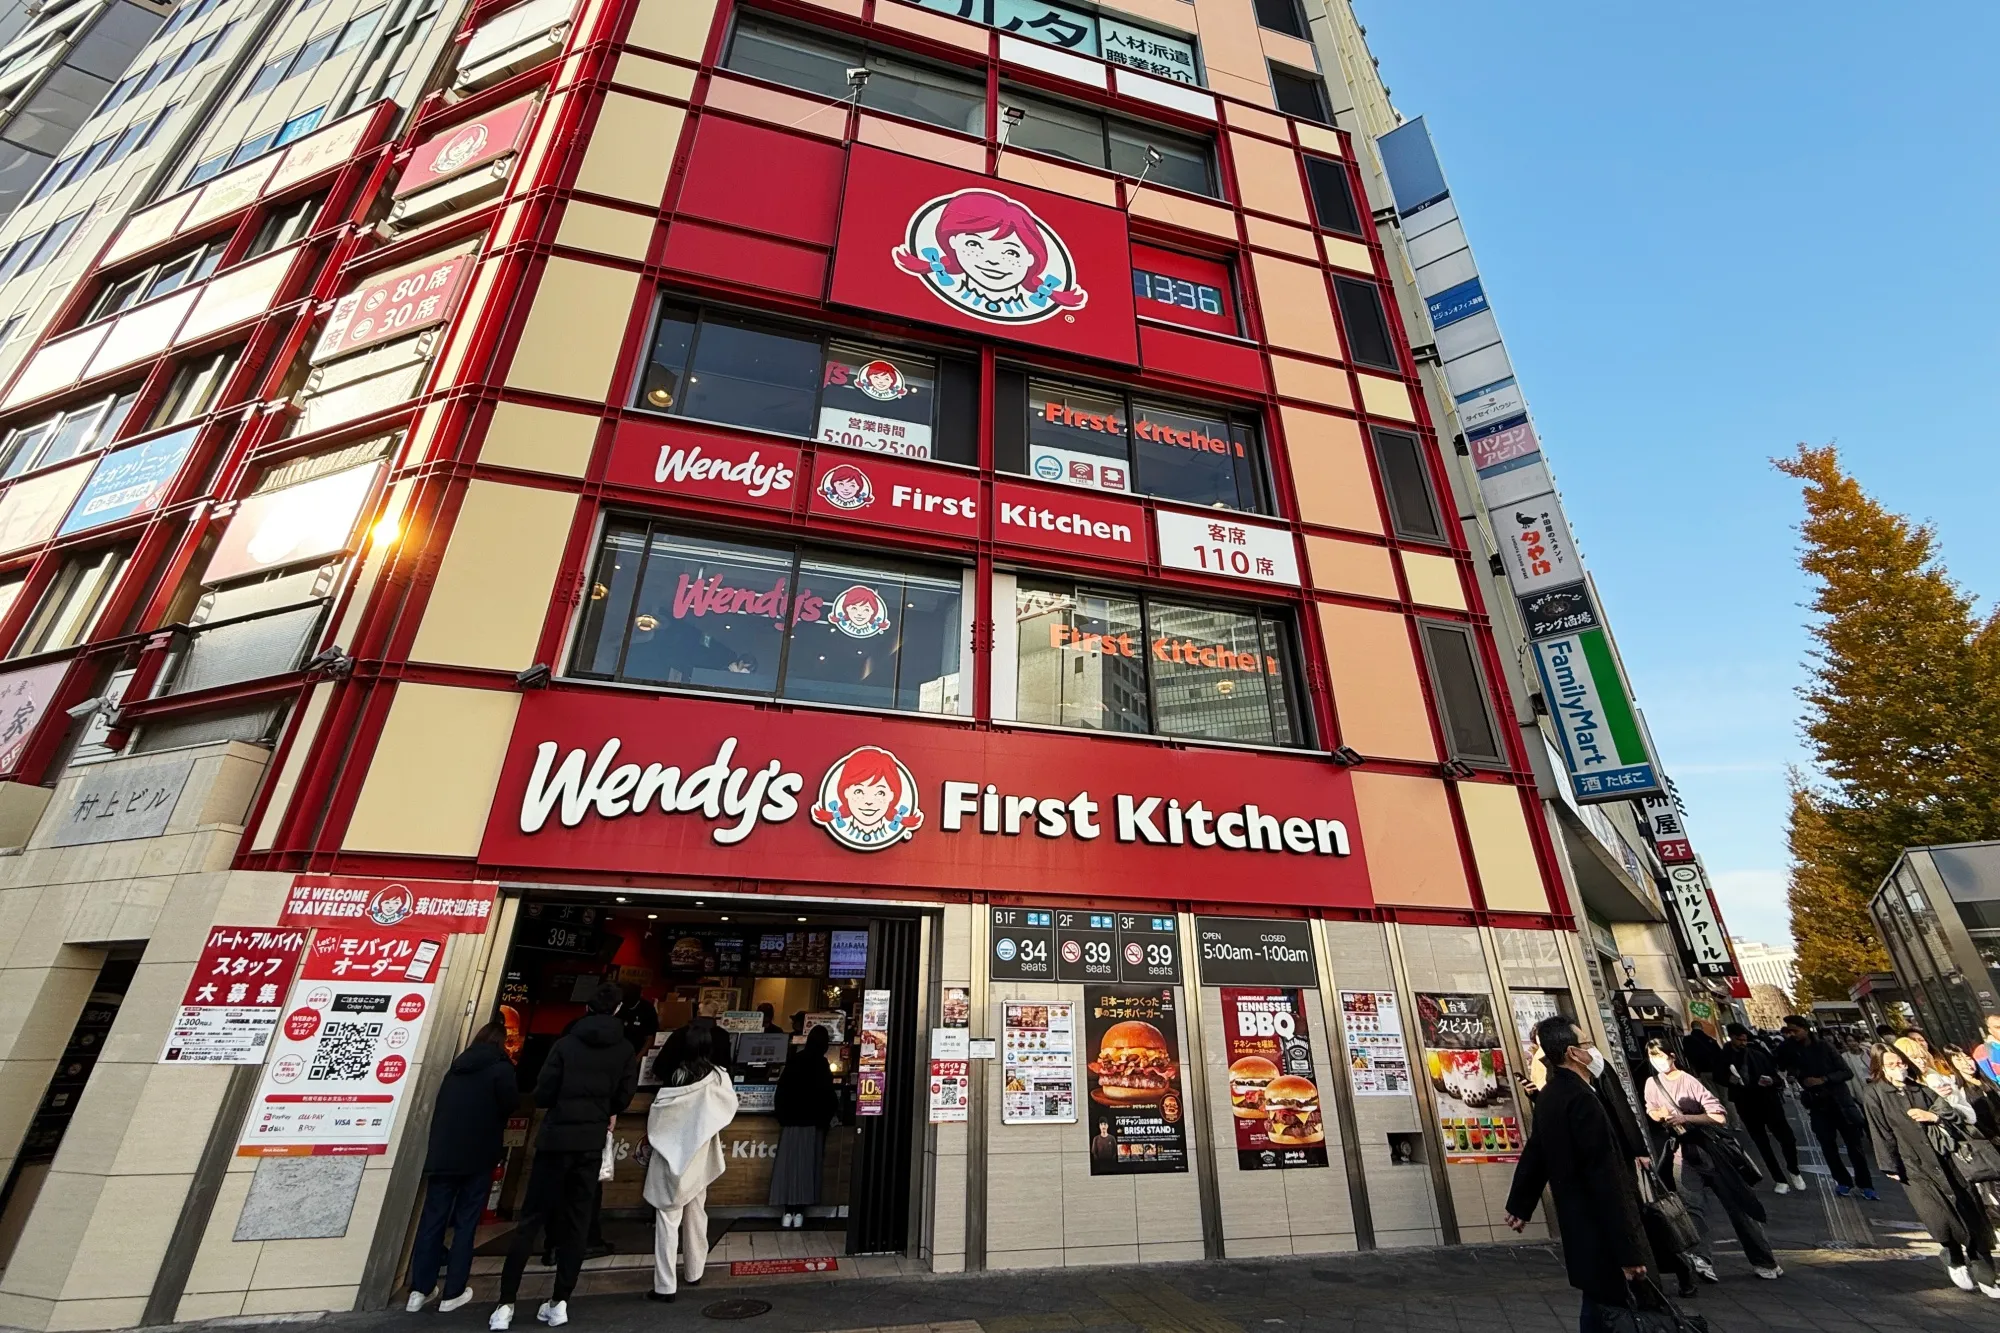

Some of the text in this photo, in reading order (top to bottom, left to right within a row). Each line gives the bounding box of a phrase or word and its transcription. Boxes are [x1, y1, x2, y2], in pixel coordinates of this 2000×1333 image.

[1105, 30, 1190, 66] 人材派遣
[1106, 48, 1193, 83] 職業紹介
[392, 265, 453, 303] 80席
[1145, 274, 1218, 315] 13:36
[377, 295, 441, 333] 30席
[1431, 302, 1441, 312] 6F
[848, 417, 906, 439] 営業時間
[1045, 403, 1245, 458] First Kitchen
[1490, 425, 1504, 433] 2F
[1477, 428, 1526, 453] パソコン
[1483, 441, 1526, 464] アビバ
[654, 444, 793, 497] Wendy's
[892, 486, 1132, 543] First Kitchen
[1207, 524, 1246, 546] 客席
[1193, 546, 1274, 576] 110席
[672, 574, 824, 631] Wendy's
[1534, 611, 1592, 635] テング酒場
[1050, 623, 1278, 675] First Kitchen
[1547, 641, 1607, 766] FamilyMart
[1581, 772, 1646, 792] 酒 たばこ
[74, 788, 171, 822] 村上ビル
[519, 736, 1351, 856] Wendy's First Kitchen
[1662, 844, 1686, 857] 2F
[293, 887, 370, 902] WE WELCOME
[287, 901, 364, 918] TRAVELERS
[415, 898, 491, 918] 我们欢迎旅客
[995, 911, 1016, 925] B1F
[1059, 914, 1074, 927] 2F
[1121, 917, 1135, 929] 3F
[1684, 894, 1721, 960] ルノアール
[208, 932, 304, 952] パート・アルバイト
[316, 936, 336, 948] Let's
[760, 941, 784, 951] BBQ
[1202, 932, 1222, 940] OPEN
[1260, 934, 1286, 943] CLOSED
[318, 944, 336, 955] Try!
[340, 938, 412, 958] モバイル
[1020, 940, 1047, 962] 34
[1084, 942, 1111, 964] 39
[1147, 944, 1173, 966] 39
[1204, 943, 1253, 960] 5:00am
[1262, 945, 1309, 962] 1:00am
[212, 957, 283, 976] スタッフ
[332, 958, 407, 977] オーダー
[1021, 962, 1047, 972] seats
[1086, 964, 1111, 974] seats
[1148, 966, 1173, 976] seats
[1709, 963, 1724, 973] B1
[195, 983, 278, 1004] 大募集
[341, 996, 385, 1004] ご注文はここから
[1101, 996, 1160, 1007] 日本一がつくった
[1236, 1002, 1292, 1012] TENNESSEE
[1448, 1001, 1468, 1013] 台湾
[1238, 1011, 1295, 1041] BBQ
[1437, 1017, 1484, 1035] タピオカ
[860, 1079, 882, 1095] 10%
[1124, 1126, 1171, 1135] BRISK STAND
